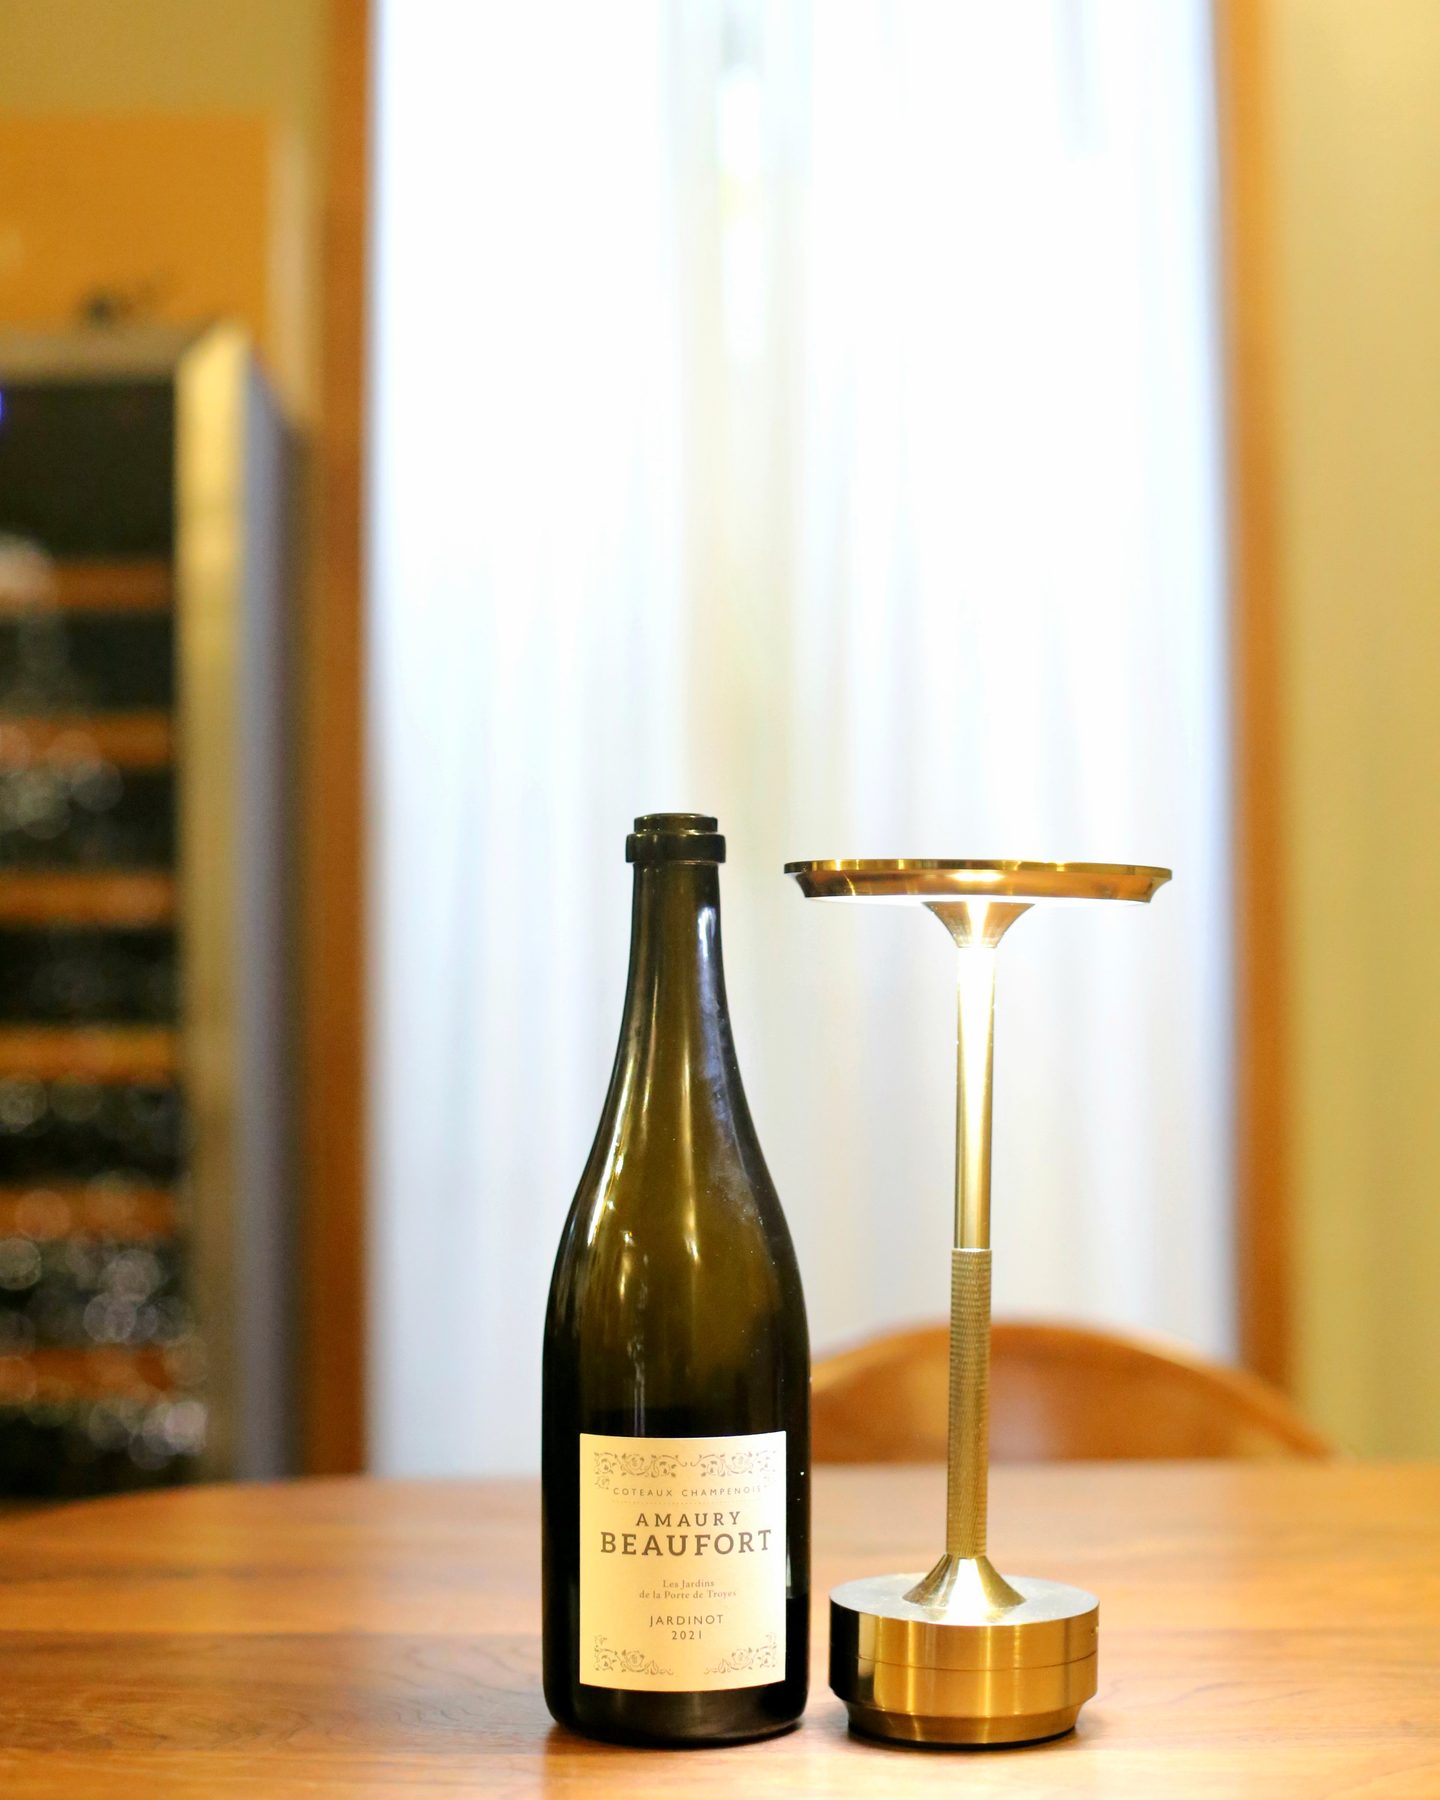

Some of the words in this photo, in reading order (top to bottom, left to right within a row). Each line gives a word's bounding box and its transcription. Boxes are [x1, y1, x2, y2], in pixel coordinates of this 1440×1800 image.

[613, 1487, 673, 1497] COTEAUX
[636, 1511, 741, 1527] AMAURY
[600, 1529, 771, 1556] BEAUFORT
[663, 1579, 679, 1588] Les
[680, 1579, 715, 1590] Jardins
[639, 1590, 650, 1599] de
[652, 1590, 661, 1599] la
[664, 1590, 690, 1599] Porte
[692, 1590, 703, 1599] de
[706, 1589, 737, 1600] Troyes
[649, 1614, 724, 1627] JARDINOT
[671, 1629, 702, 1640] 2021
